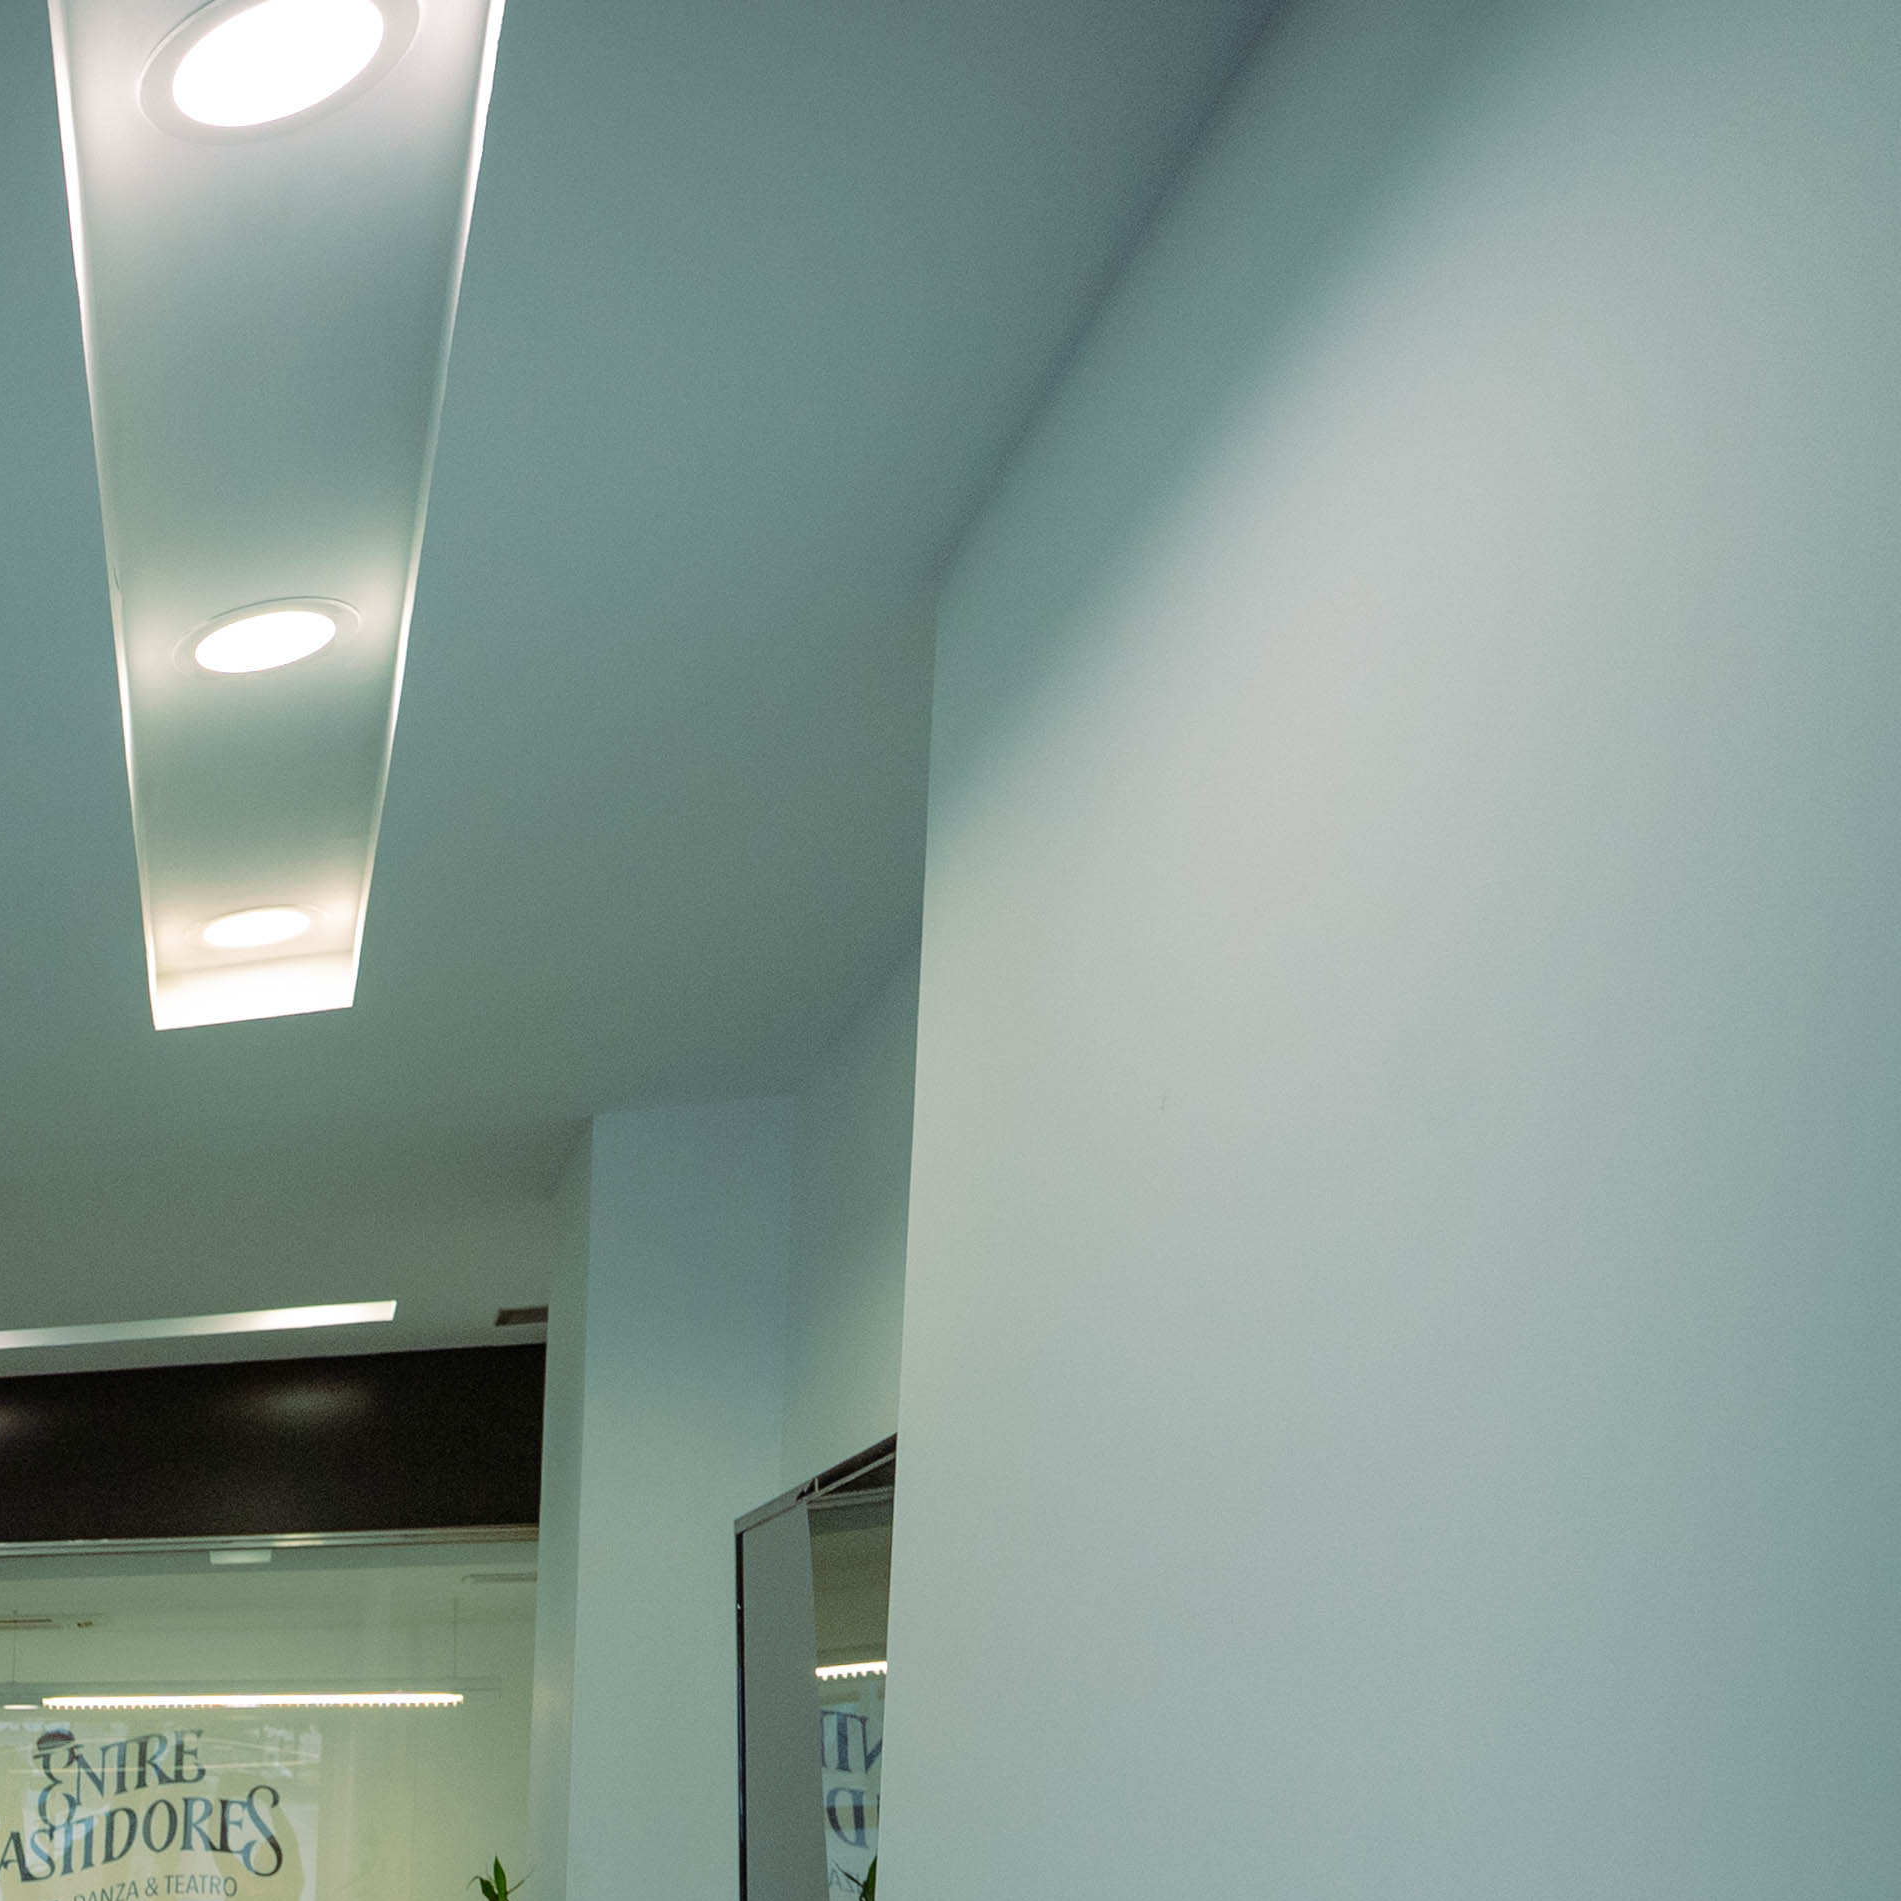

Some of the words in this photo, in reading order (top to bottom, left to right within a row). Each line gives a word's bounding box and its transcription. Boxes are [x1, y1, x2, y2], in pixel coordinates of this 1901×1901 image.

[32, 1729, 207, 1838] ENTRE
[146, 1878, 160, 1898] &
[163, 1874, 238, 1898] TEATRO
